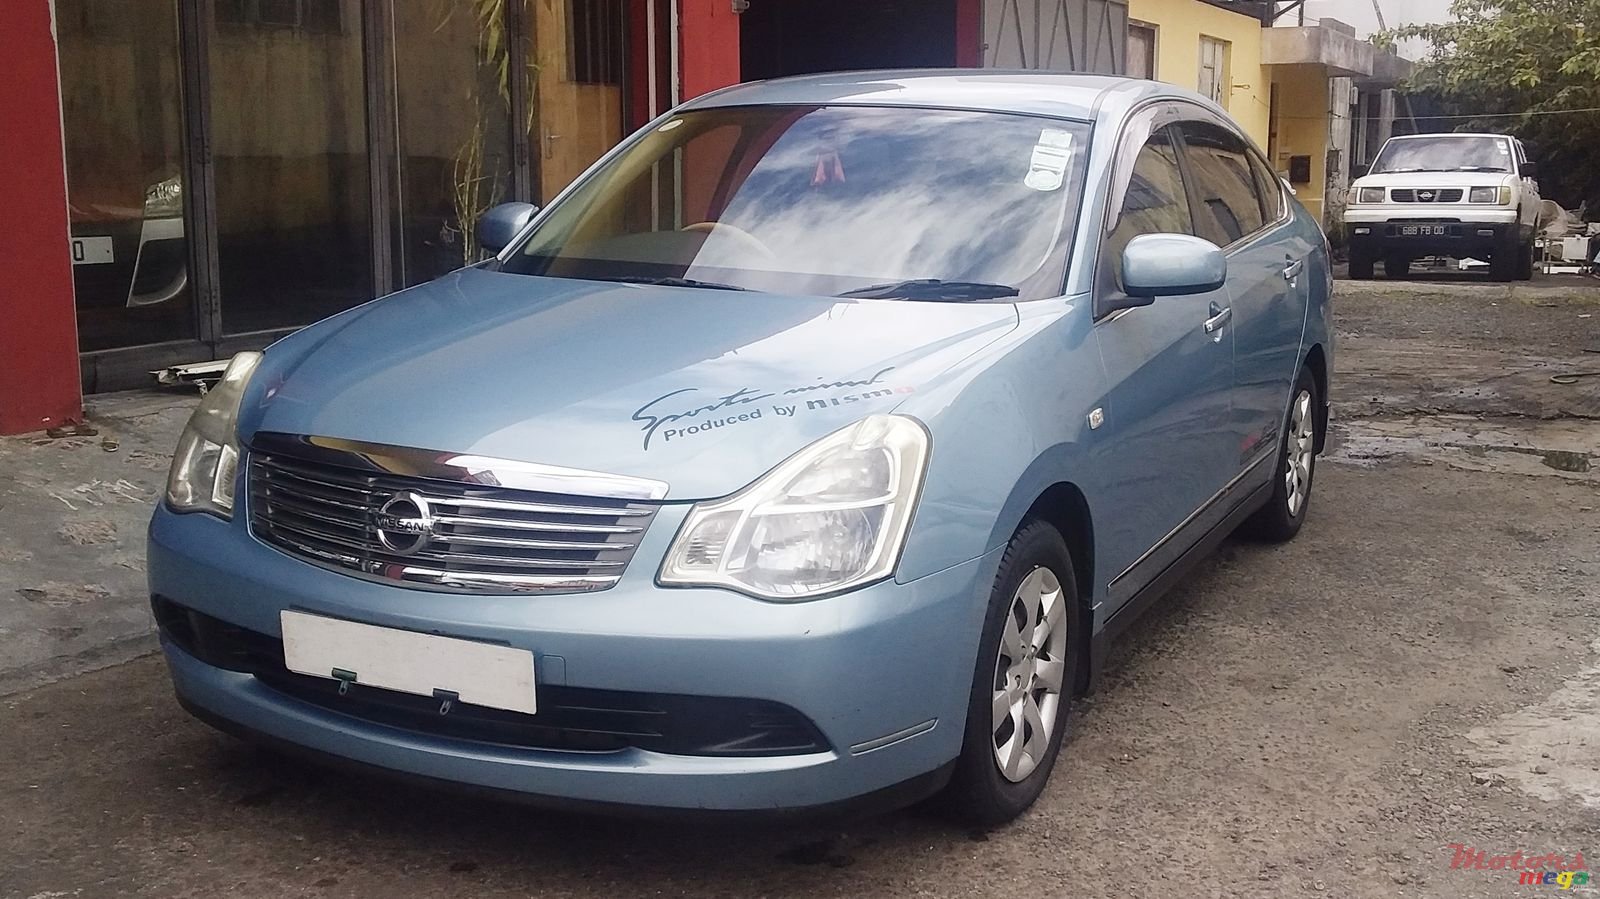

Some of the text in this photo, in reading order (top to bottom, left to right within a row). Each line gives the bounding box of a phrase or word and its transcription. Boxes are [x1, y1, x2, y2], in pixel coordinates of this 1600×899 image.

[783, 366, 896, 395] mind
[663, 385, 914, 442] Produced by nismo
[375, 517, 424, 532] NISSAN
